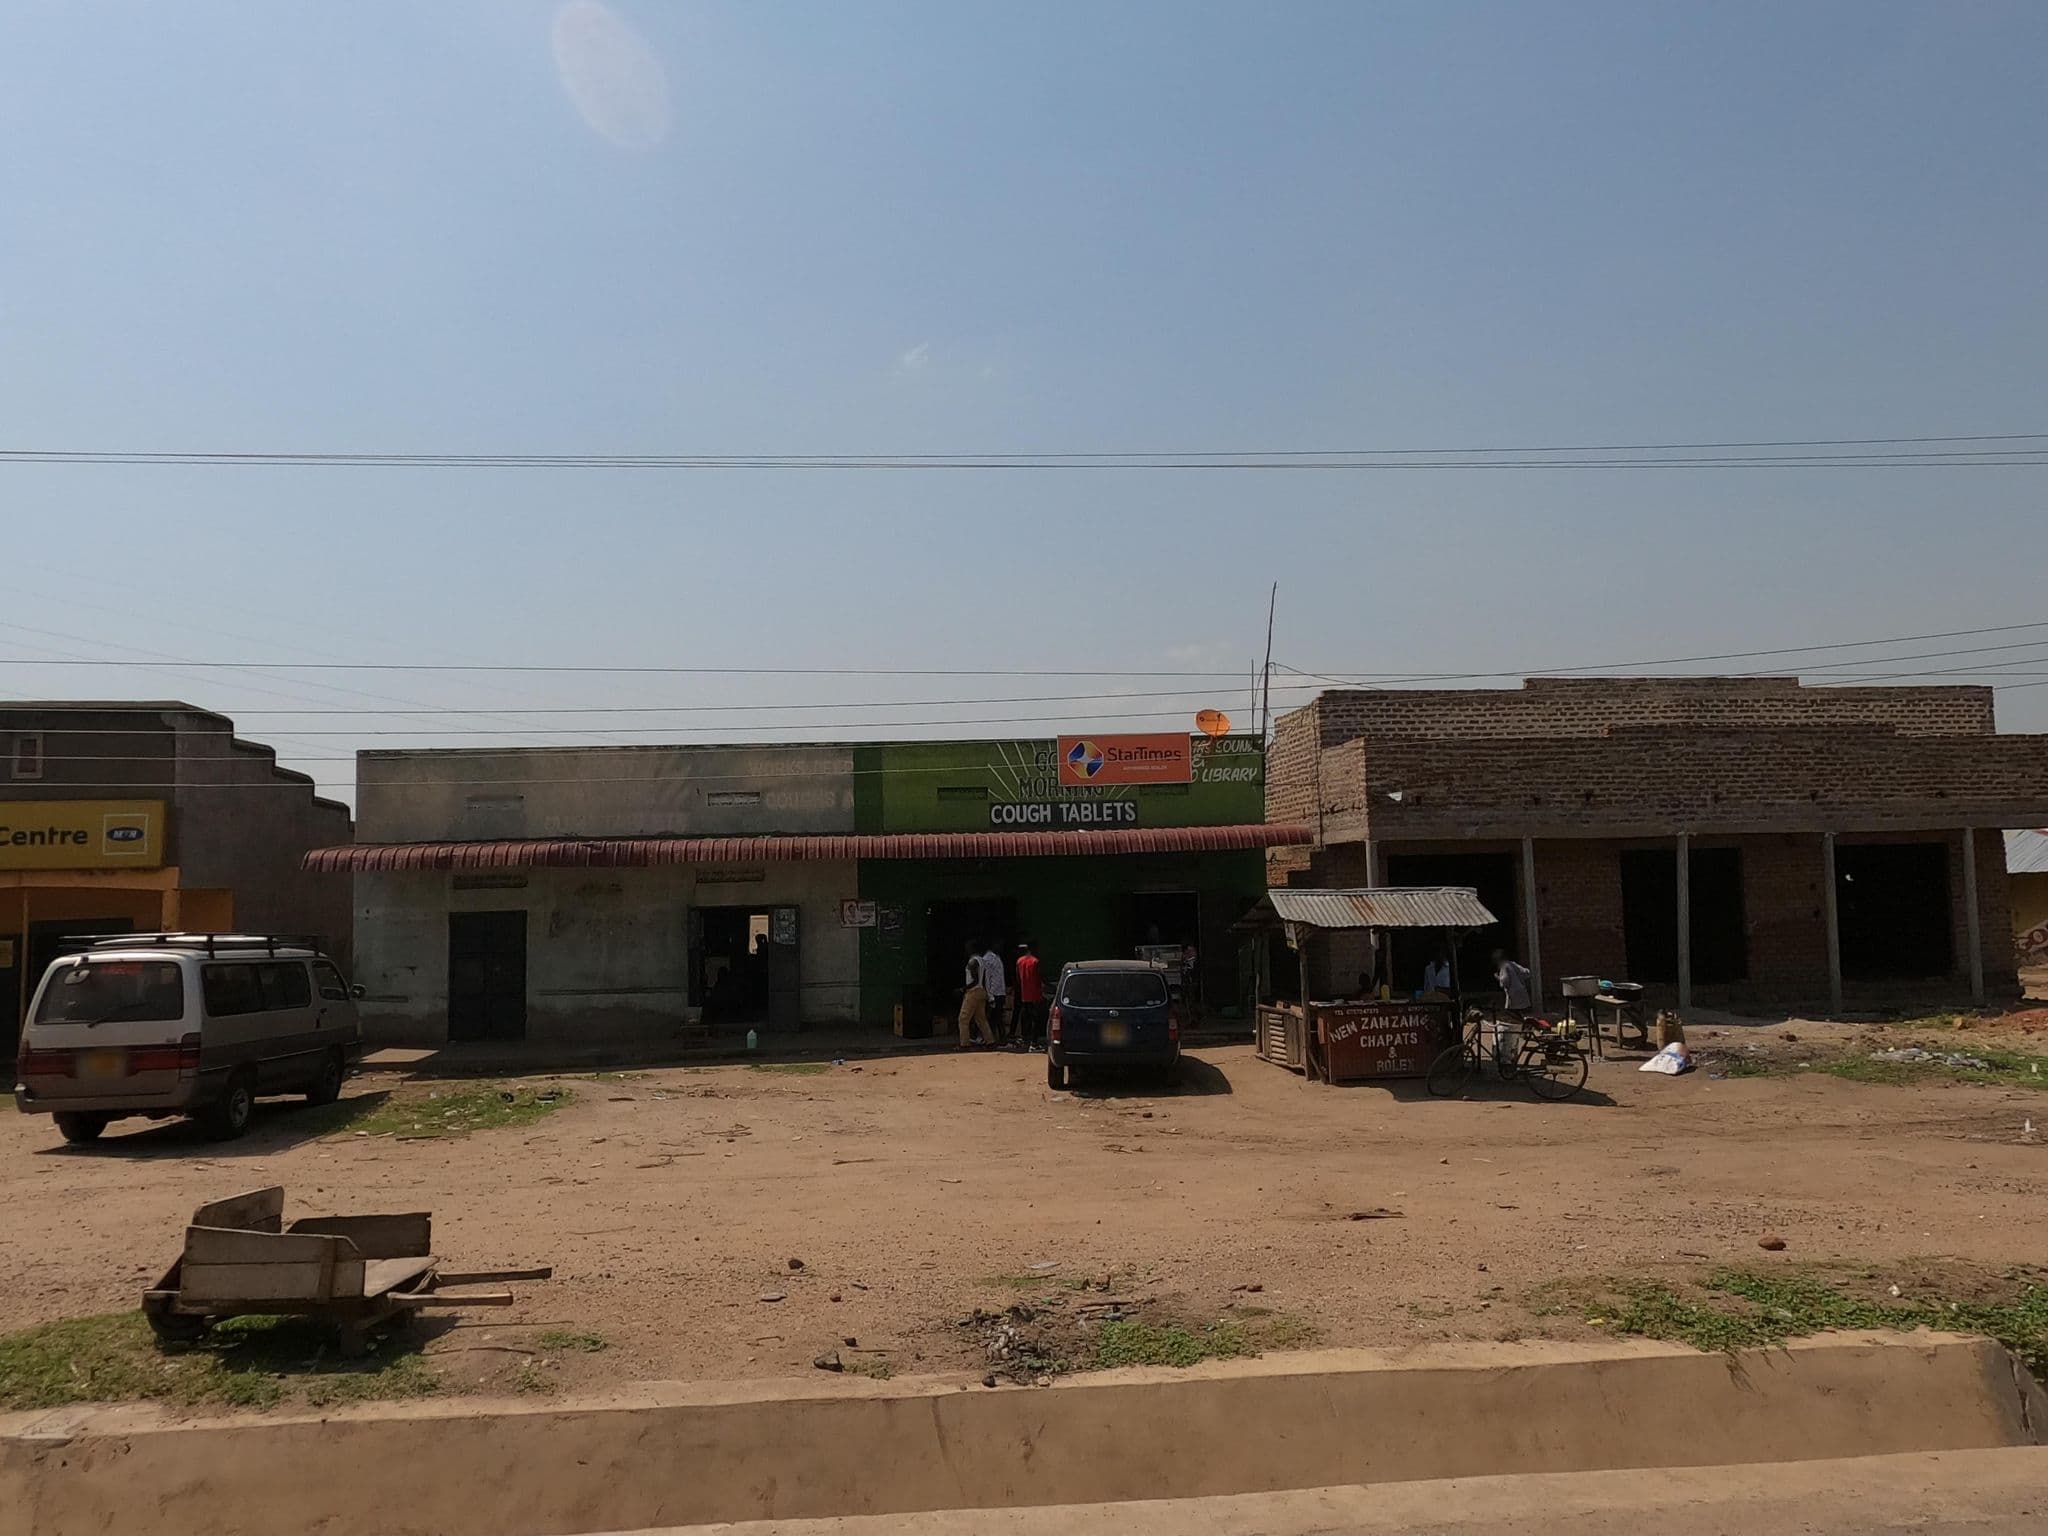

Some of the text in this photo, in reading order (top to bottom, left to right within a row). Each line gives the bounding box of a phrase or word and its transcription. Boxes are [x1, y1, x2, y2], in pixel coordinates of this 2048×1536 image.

[1107, 746, 1182, 761] StarTimes
[1035, 752, 1058, 772] GO
[1201, 767, 1258, 783] LIBRARY
[991, 802, 1136, 823] COUGH TABLETS
[0, 826, 88, 846] Centre
[1330, 1021, 1358, 1043] NEW
[1360, 1032, 1418, 1048] CHAPATS
[1388, 1047, 1397, 1058] &
[1376, 1059, 1415, 1073] ROLEX
